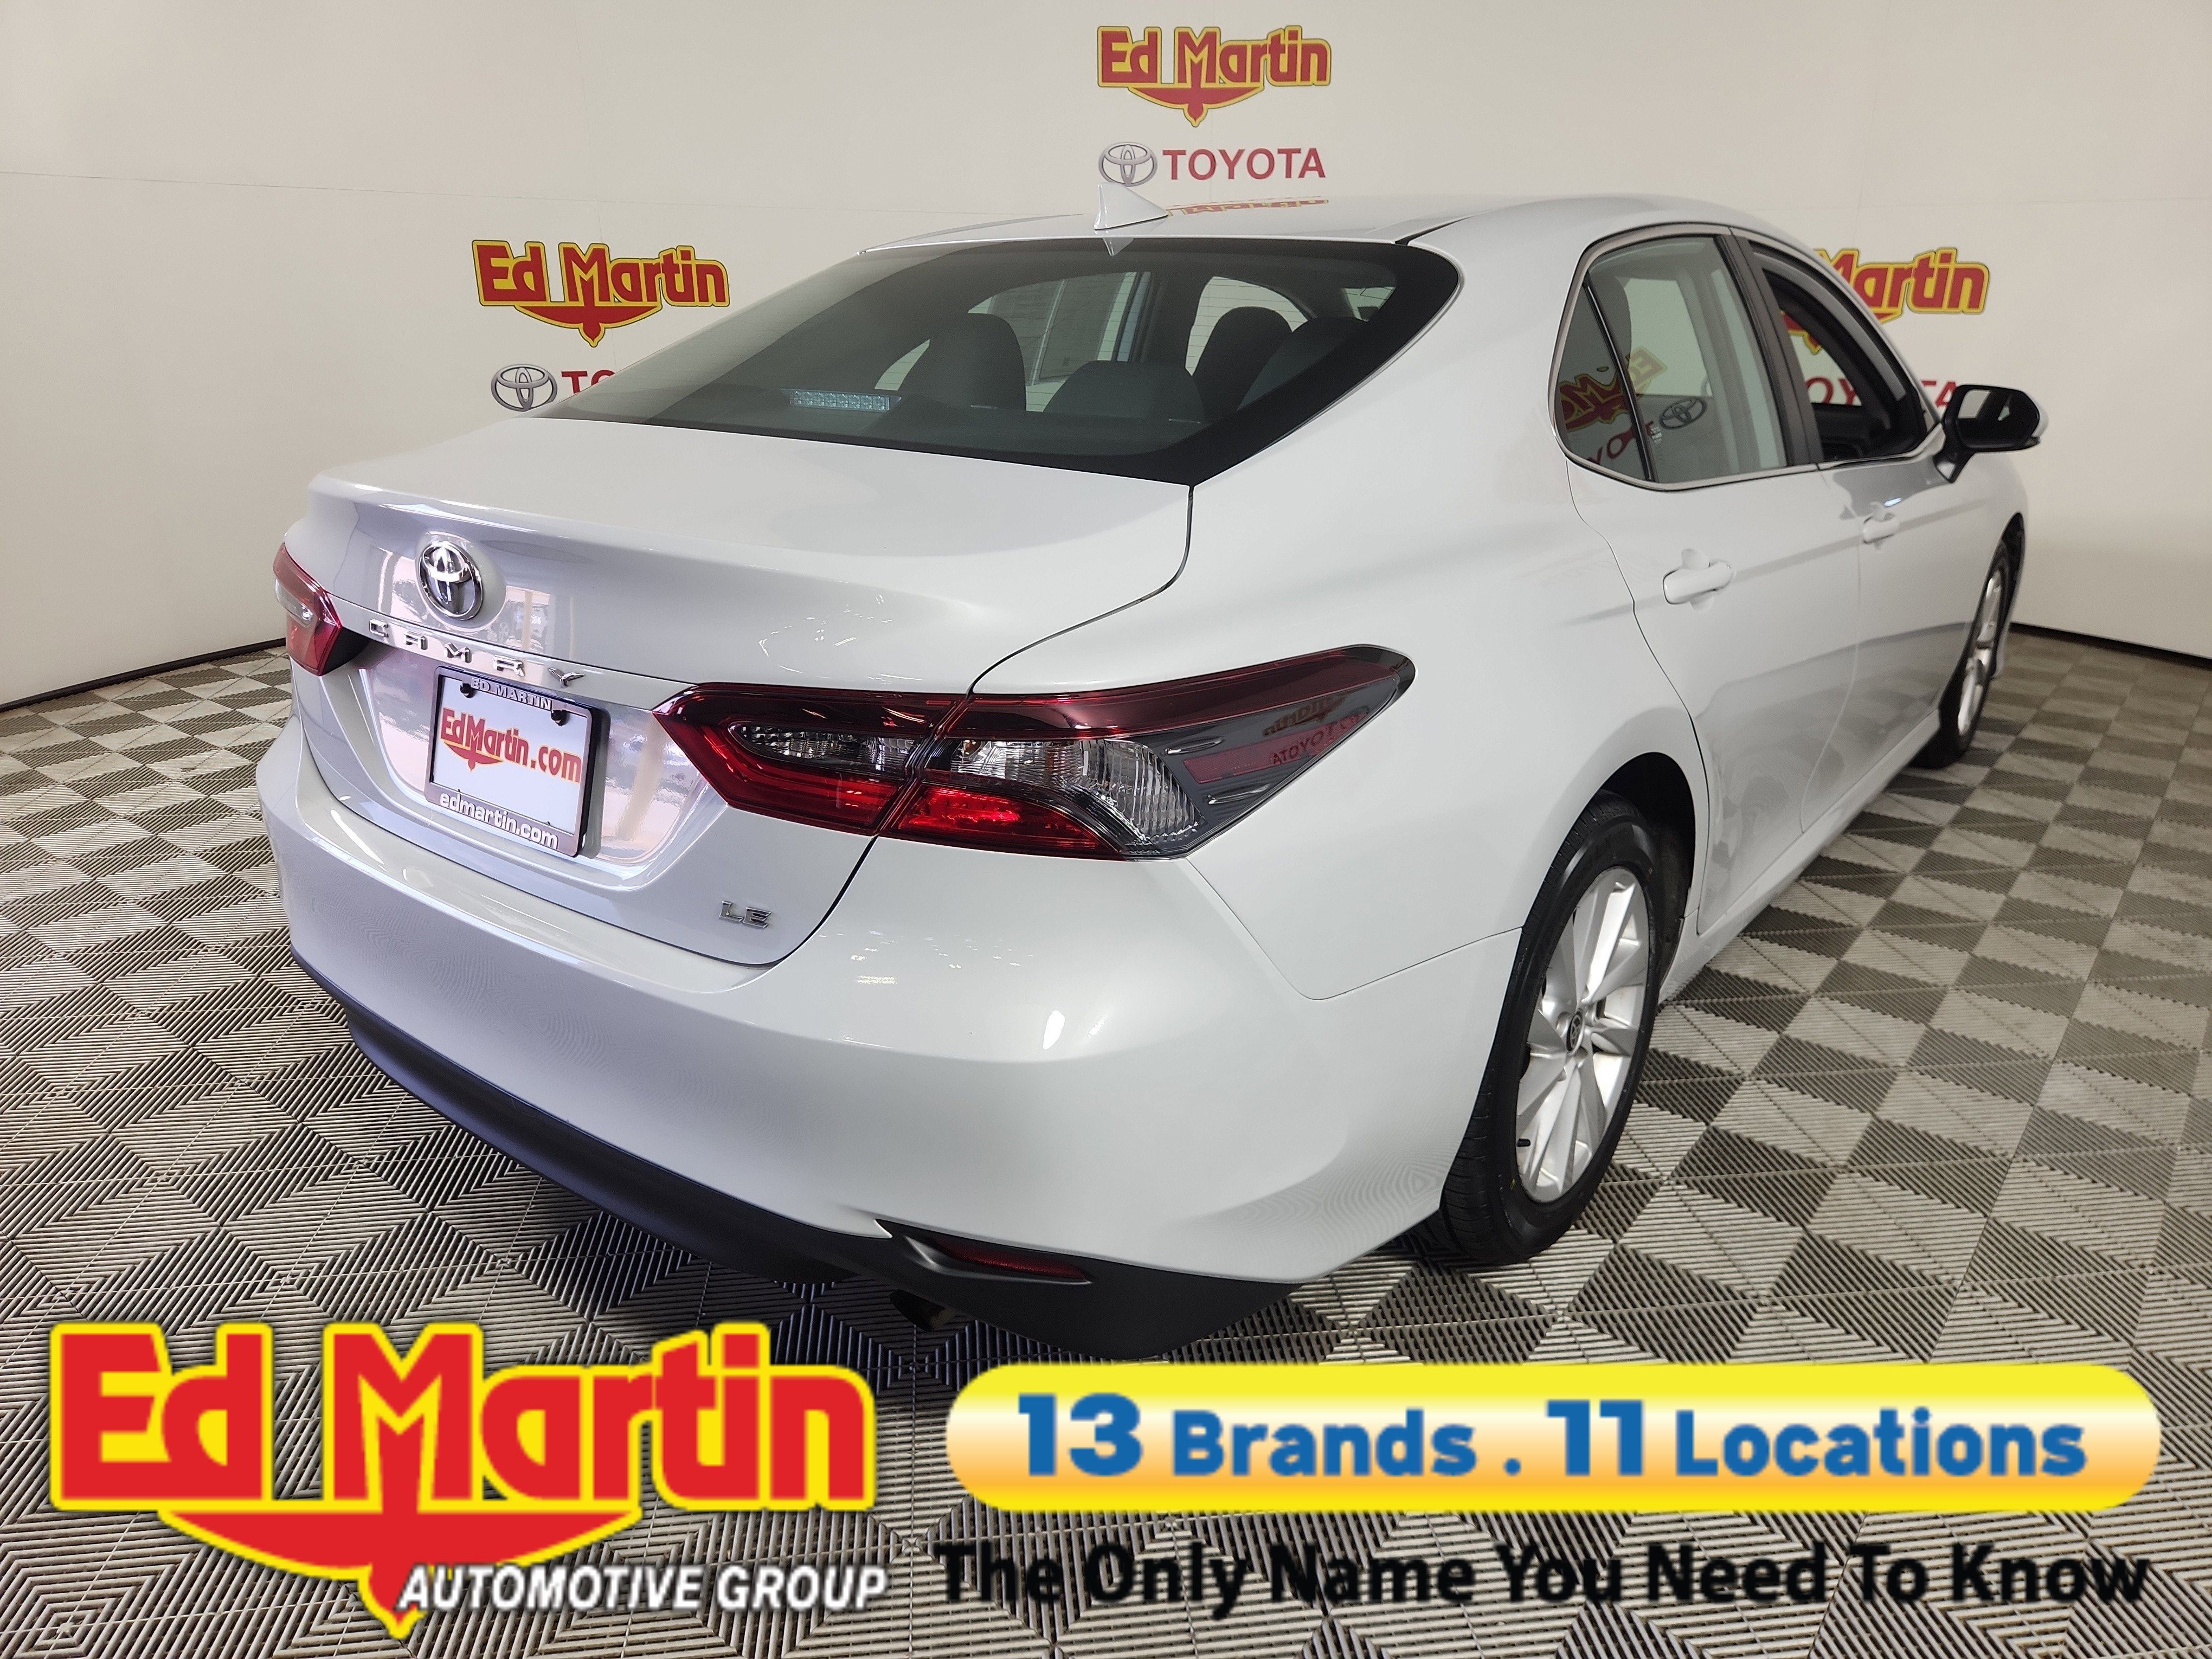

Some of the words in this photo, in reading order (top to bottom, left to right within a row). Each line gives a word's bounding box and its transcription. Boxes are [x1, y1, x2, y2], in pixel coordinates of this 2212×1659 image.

[1098, 26, 1161, 87] Ed
[1174, 25, 1332, 86] Martin
[1162, 147, 1326, 181] TOYOTA
[472, 240, 550, 306] Ed
[558, 242, 730, 306] Martin
[369, 619, 586, 687] CAMRY
[471, 678, 490, 692] ED
[494, 684, 553, 711] MARTIN
[440, 707, 582, 783] EdMartin.com
[440, 793, 558, 850] edmartin.com
[719, 900, 771, 929] LE
